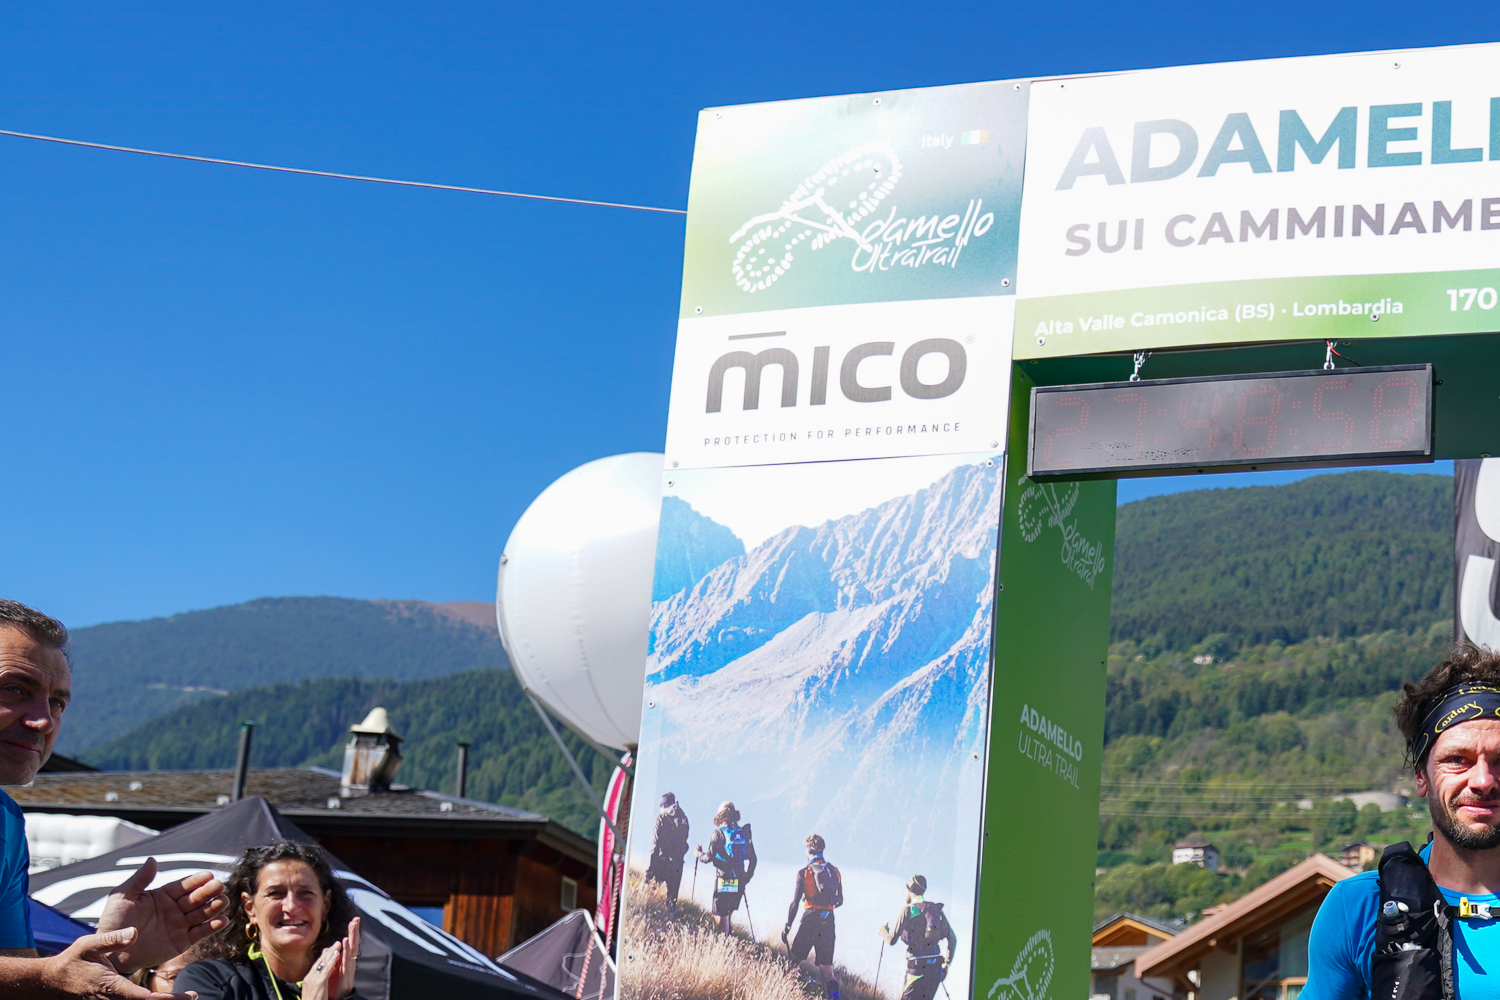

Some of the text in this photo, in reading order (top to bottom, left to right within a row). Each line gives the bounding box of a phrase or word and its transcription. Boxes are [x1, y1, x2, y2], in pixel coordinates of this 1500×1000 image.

[920, 131, 954, 150] Italy
[1064, 218, 1144, 257] SUI
[1034, 296, 1404, 338] Alta Valle Camonica (BS) Lombardia
[1446, 287, 1498, 313] 170
[703, 421, 962, 448] PROTECTION FOR PERFORMANCE
[1019, 703, 1083, 762] ADAMELLO
[1018, 730, 1080, 790] ULTRA TRAIL
